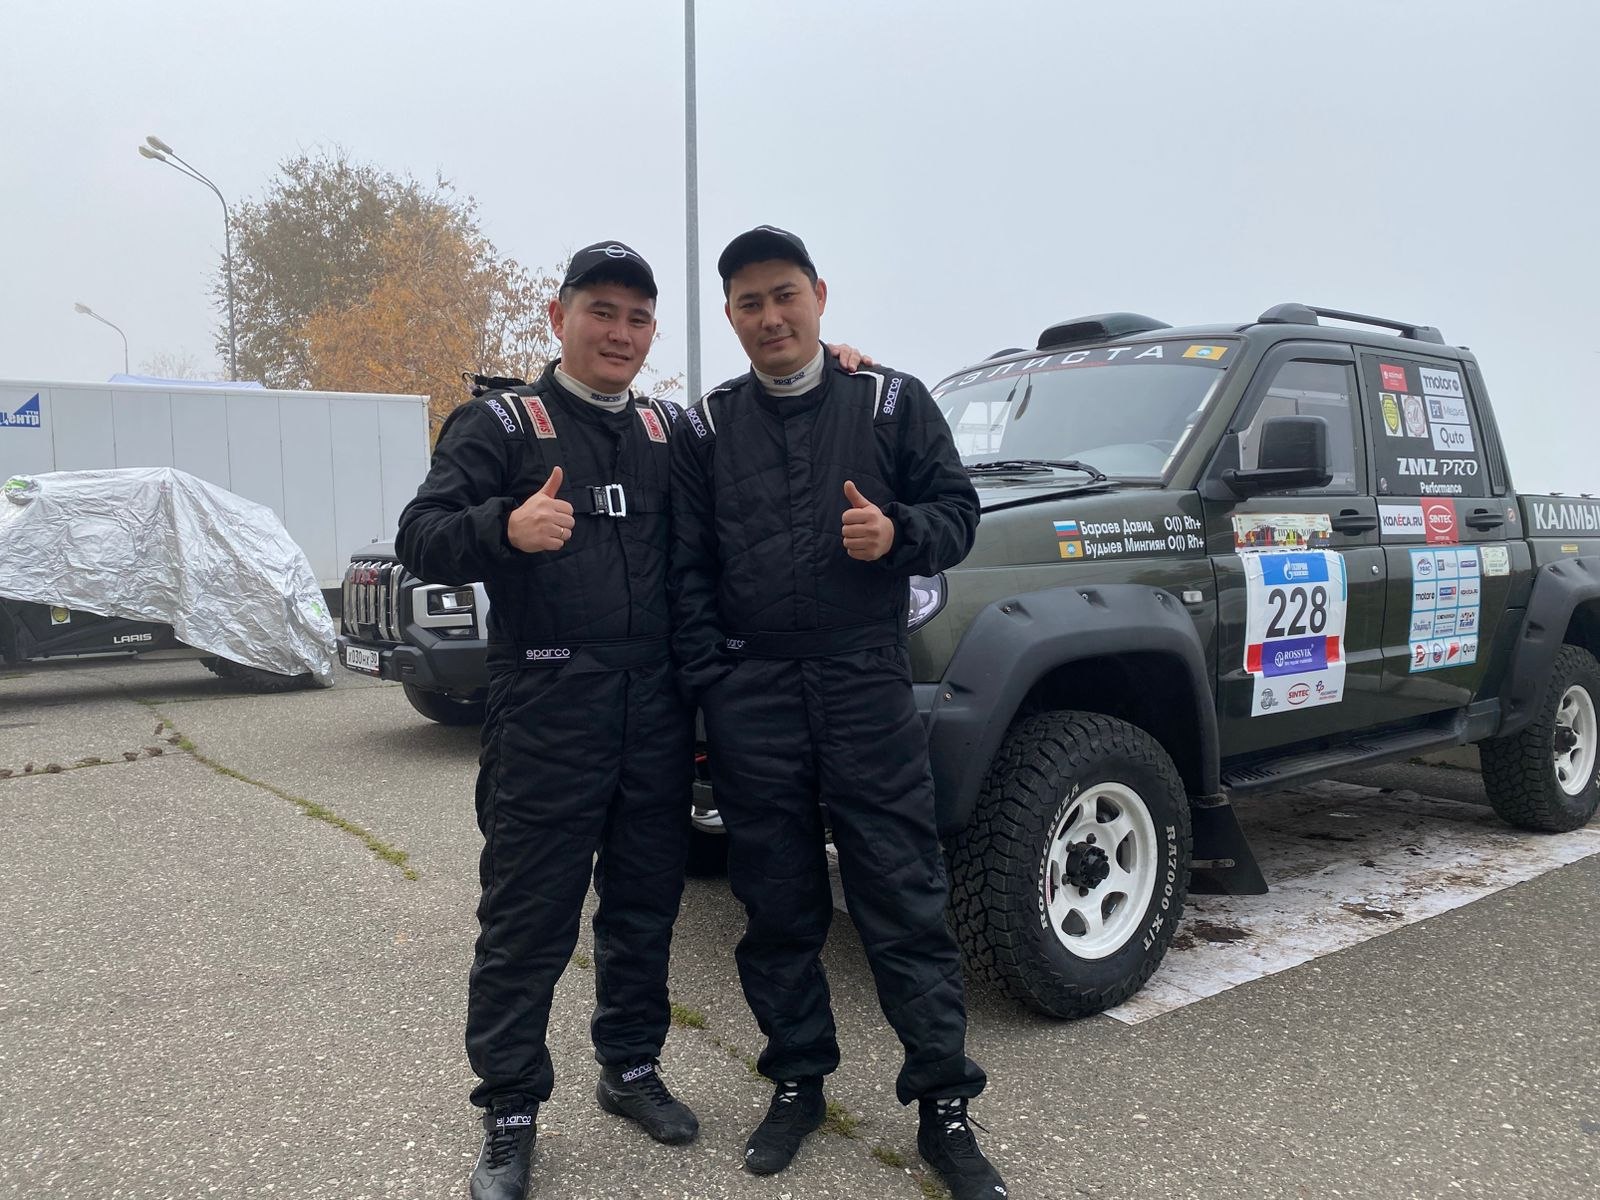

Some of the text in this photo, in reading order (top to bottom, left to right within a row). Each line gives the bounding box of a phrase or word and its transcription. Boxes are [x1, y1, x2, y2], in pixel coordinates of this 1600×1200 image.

[773, 372, 805, 385] sparco
[883, 377, 902, 415] sparco
[485, 399, 516, 434] sparco
[685, 407, 707, 438] sparco
[1440, 427, 1465, 448] Quto
[1397, 457, 1478, 476] ZMZ PRO
[1420, 481, 1462, 494] Performance
[1429, 514, 1453, 524] SINTEC
[1533, 503, 1600, 530] КАЛМЫ
[1080, 520, 1121, 538] Бараев
[1123, 518, 1155, 535] Давид
[1184, 515, 1202, 530] Rh+
[1084, 540, 1123, 558] Будыев
[1124, 537, 1166, 552] Мингиян
[1187, 534, 1204, 549] Rh+
[1266, 585, 1327, 638] 228
[113, 633, 152, 644] LARIS
[526, 648, 570, 660] sparco
[1284, 648, 1312, 660] ROSSVIK
[1288, 689, 1310, 699] SINTEC
[622, 1063, 653, 1082] sparco
